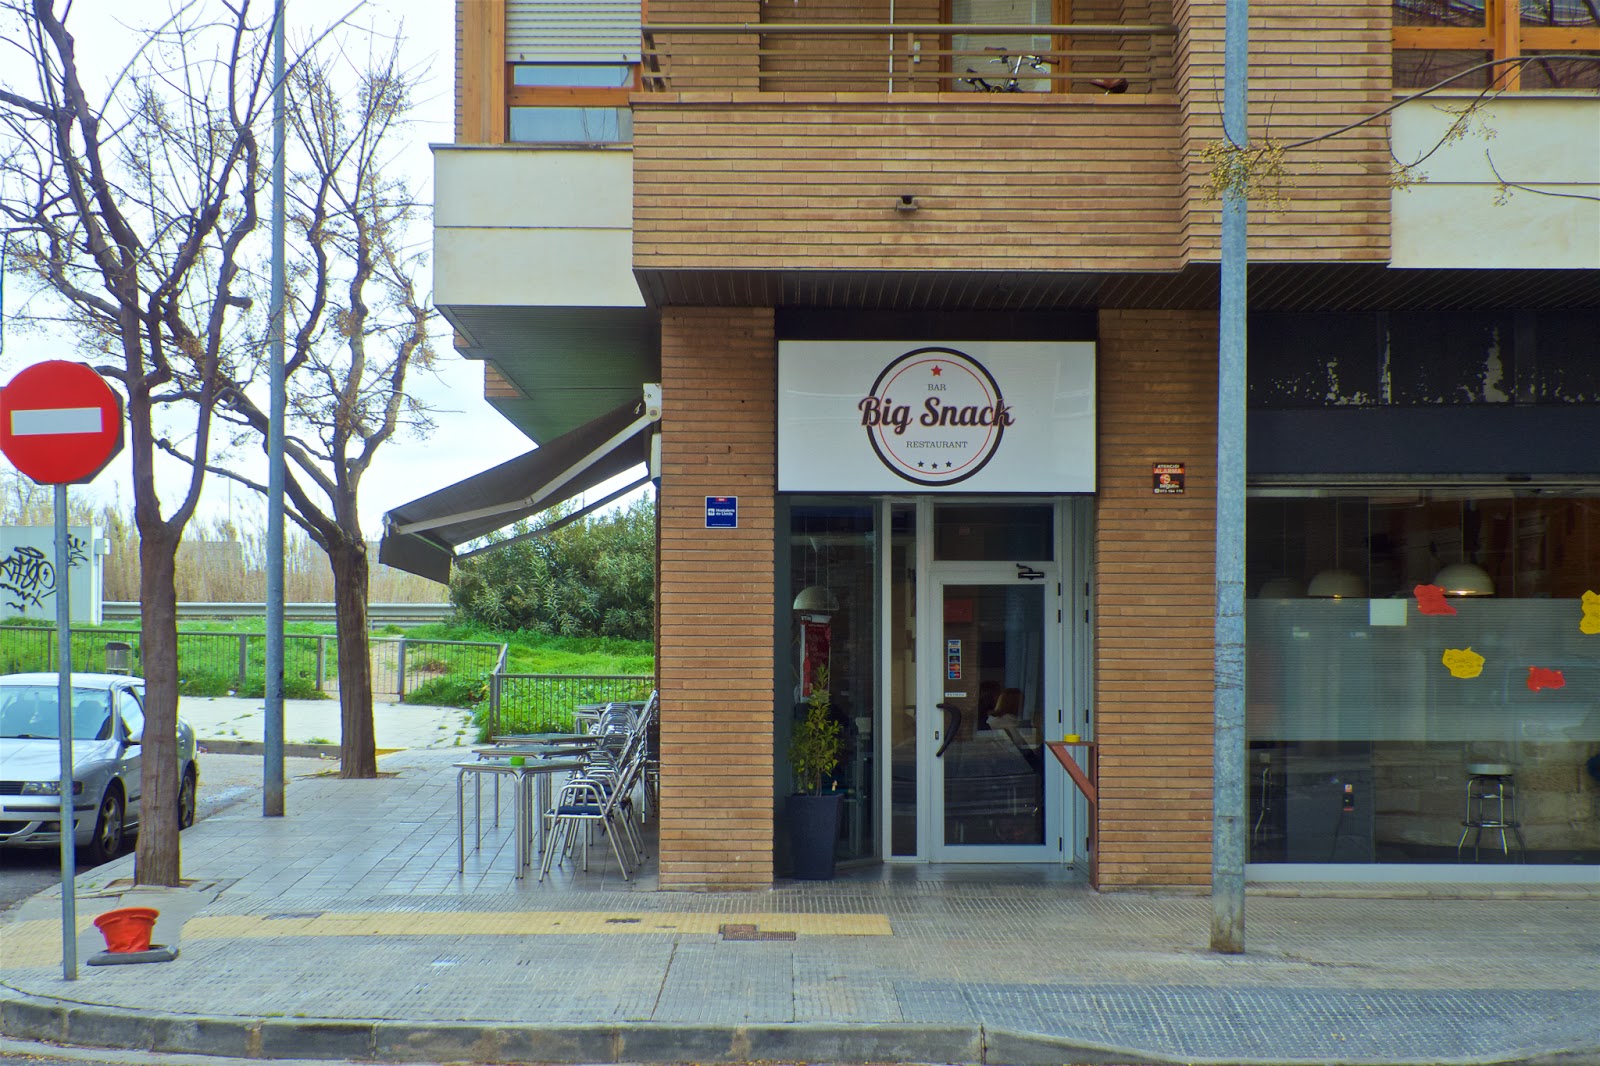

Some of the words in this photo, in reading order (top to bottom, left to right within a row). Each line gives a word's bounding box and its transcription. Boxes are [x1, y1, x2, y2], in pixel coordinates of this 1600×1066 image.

[927, 383, 947, 391] BAR
[858, 396, 913, 435] Big
[920, 397, 1016, 427] Snack
